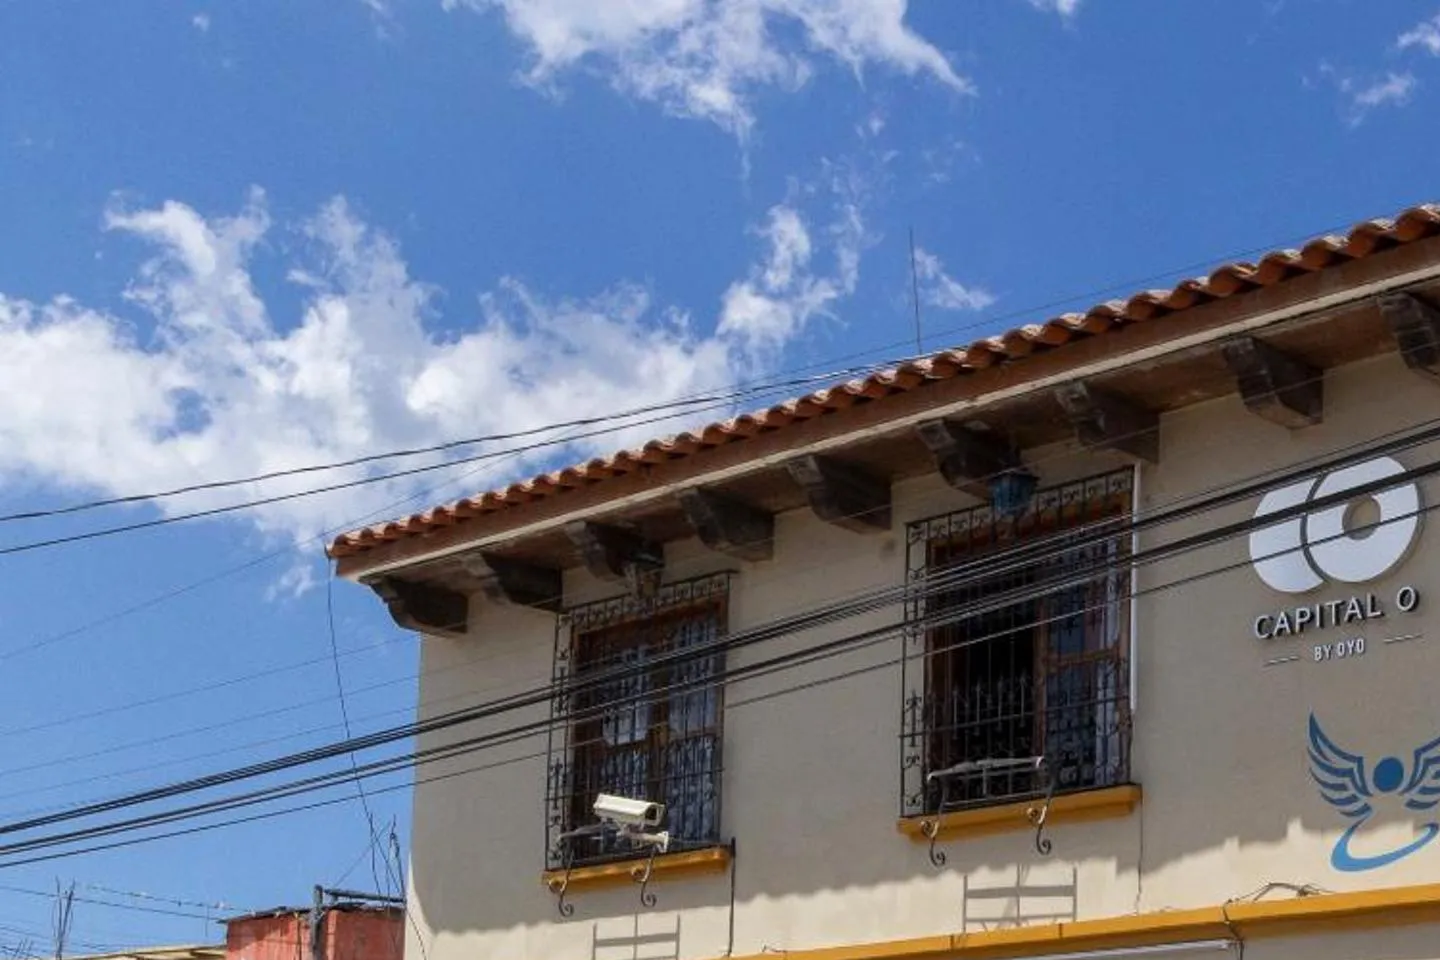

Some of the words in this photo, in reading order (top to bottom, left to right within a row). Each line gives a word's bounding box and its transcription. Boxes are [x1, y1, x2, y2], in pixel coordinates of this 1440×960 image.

[1254, 594, 1382, 639] CAPITAL
[1396, 586, 1418, 612] O
[1314, 644, 1332, 661] BY
[1337, 638, 1365, 657] OYO
